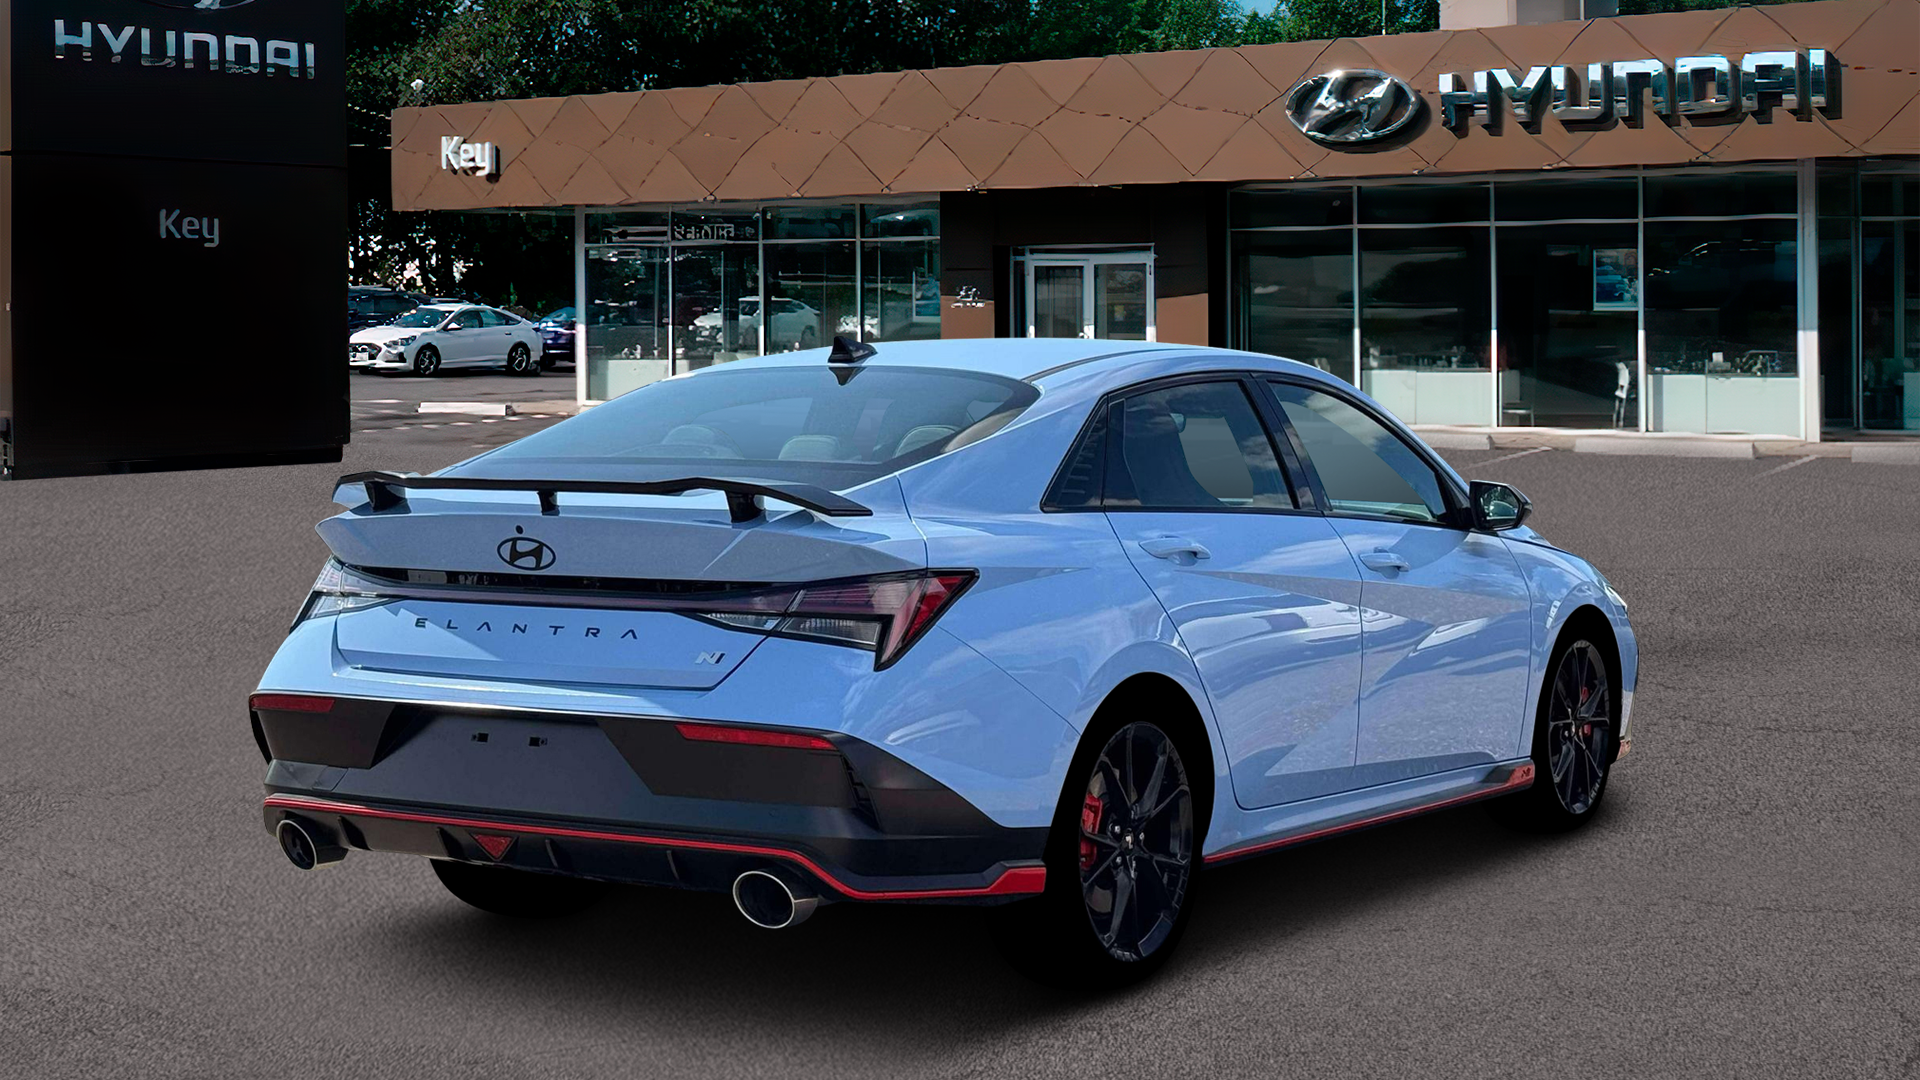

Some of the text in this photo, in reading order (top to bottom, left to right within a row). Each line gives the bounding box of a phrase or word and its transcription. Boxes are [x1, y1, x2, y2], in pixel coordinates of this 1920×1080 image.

[54, 19, 315, 79] HYUNDAI
[1438, 48, 1842, 137] HYUNDAI
[441, 135, 492, 177] Key
[159, 208, 220, 248] Key
[415, 617, 638, 640] ELANTRA
